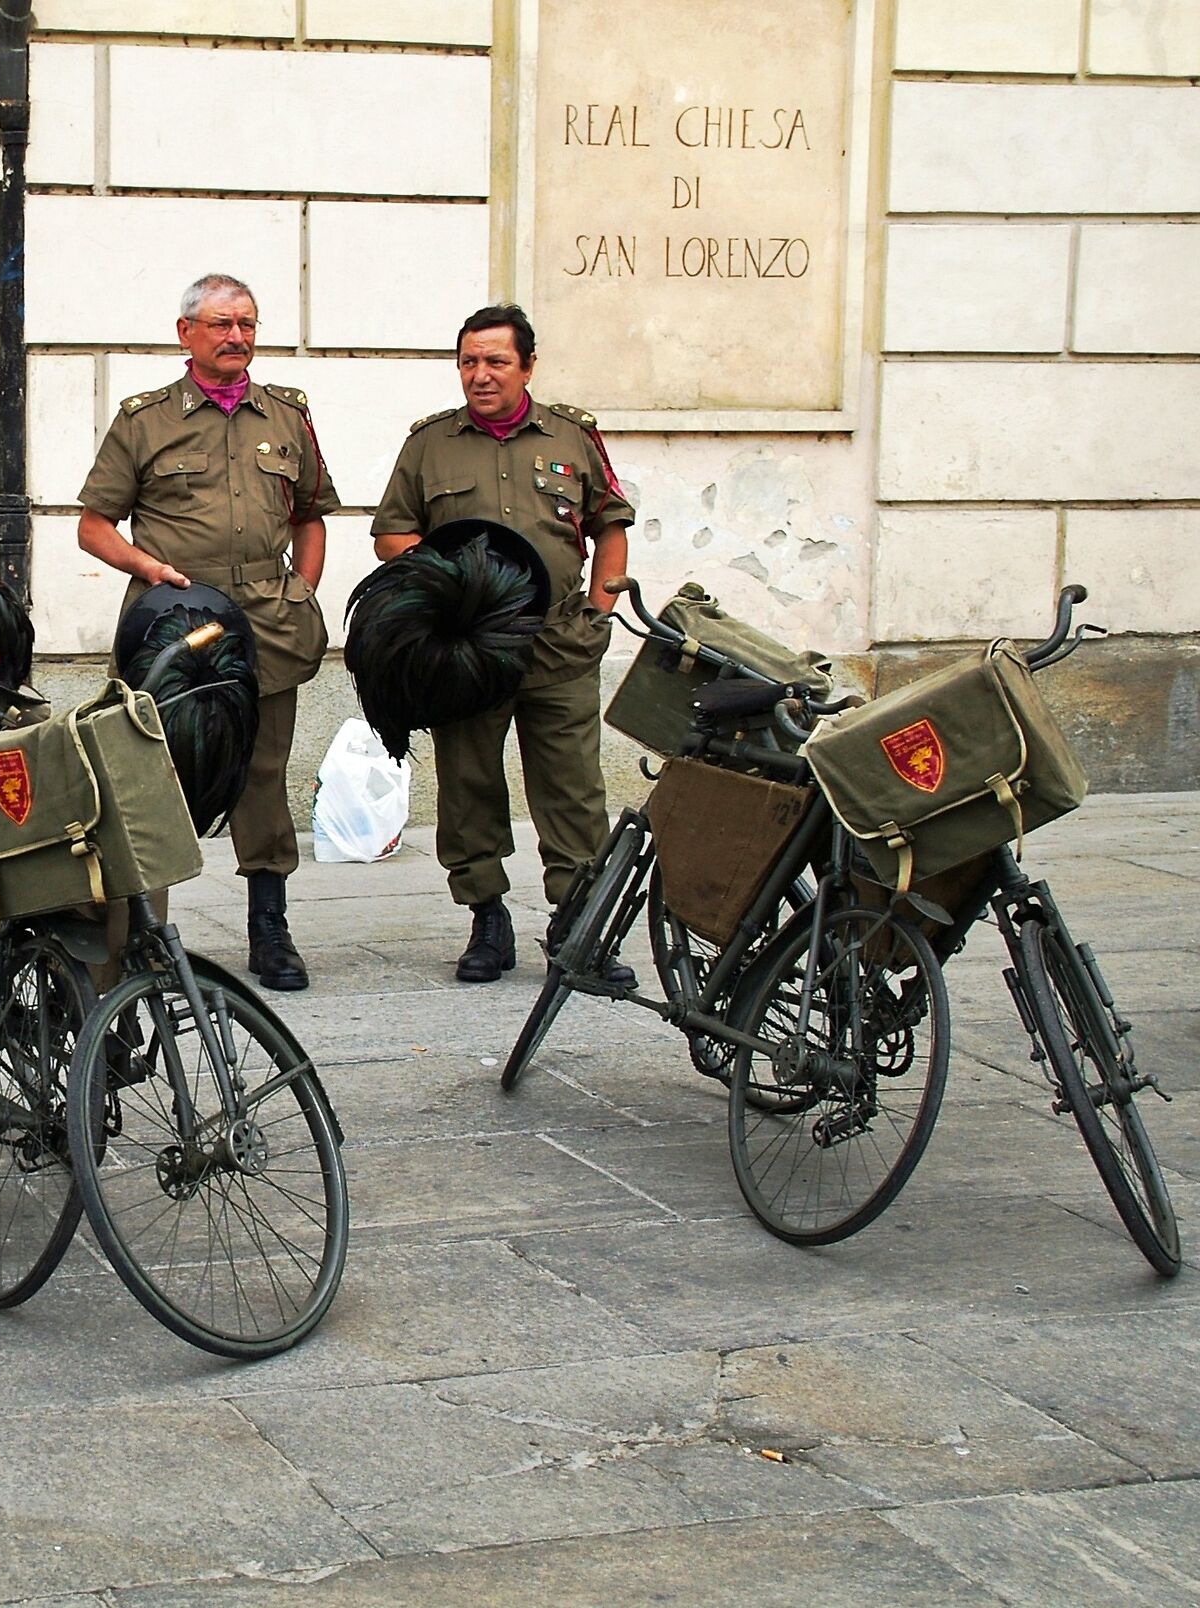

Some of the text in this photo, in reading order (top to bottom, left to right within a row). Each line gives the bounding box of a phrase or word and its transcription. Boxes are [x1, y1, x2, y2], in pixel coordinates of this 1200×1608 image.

[563, 103, 812, 151] REAL CHIESA
[671, 175, 701, 210] DI
[562, 234, 811, 279] SAN LORENZO
